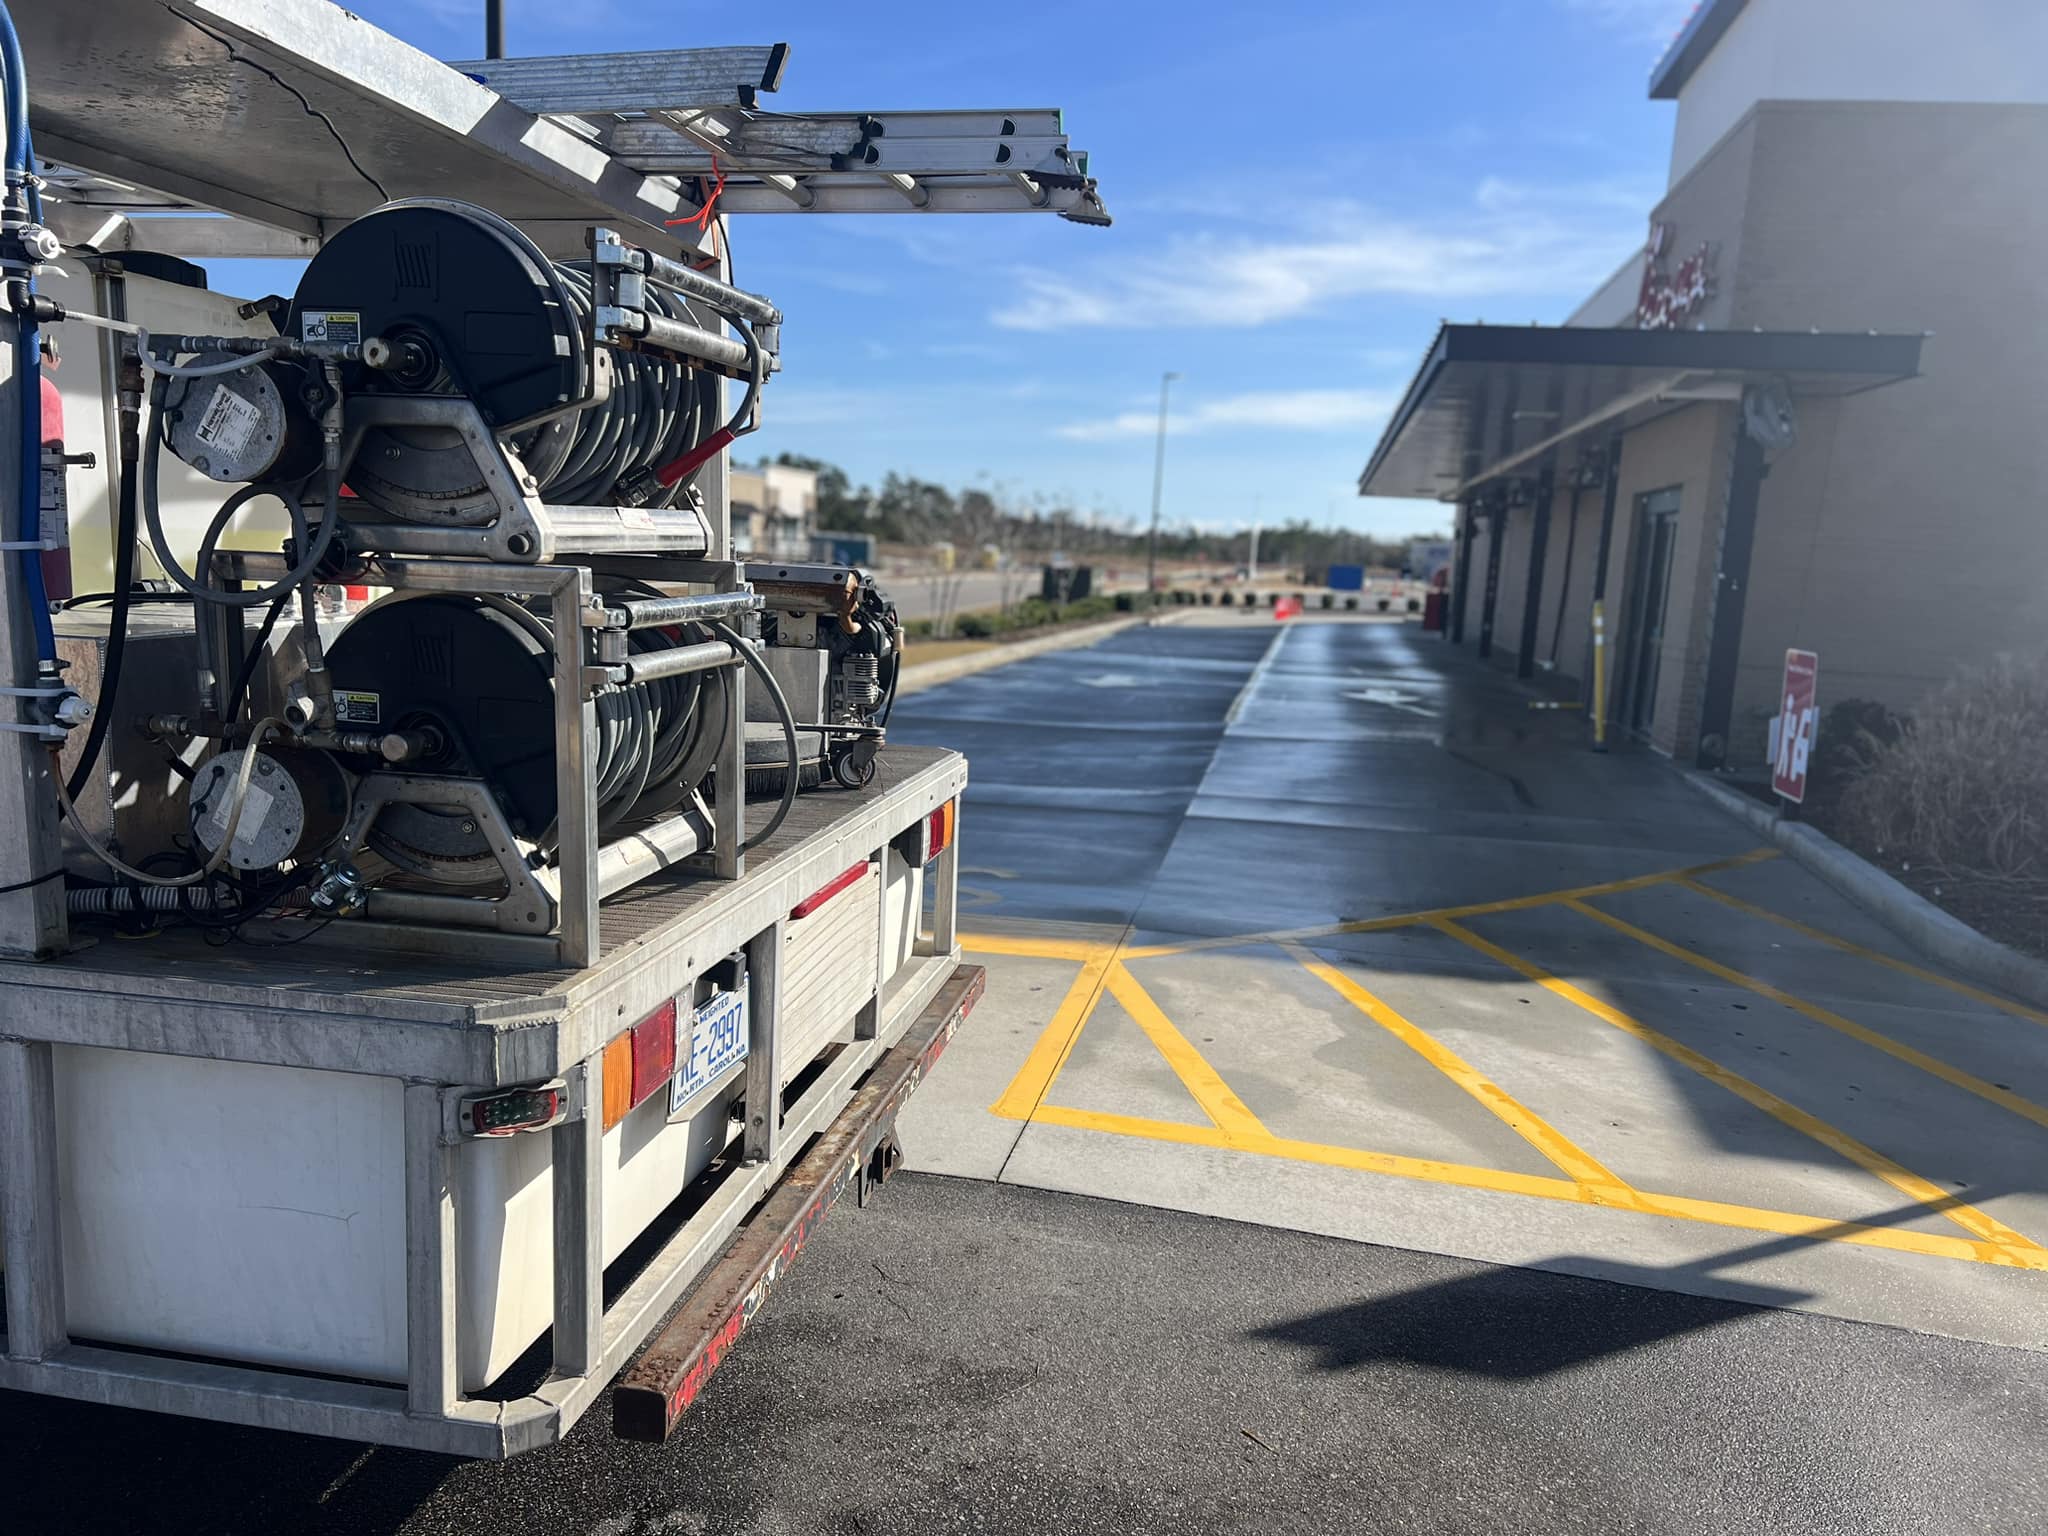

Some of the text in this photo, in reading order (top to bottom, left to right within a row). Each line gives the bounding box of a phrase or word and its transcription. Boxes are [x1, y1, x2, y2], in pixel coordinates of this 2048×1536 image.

[700, 996, 730, 1025] WEIGHTED
[676, 1043, 746, 1104] NORTH CAROLINA
